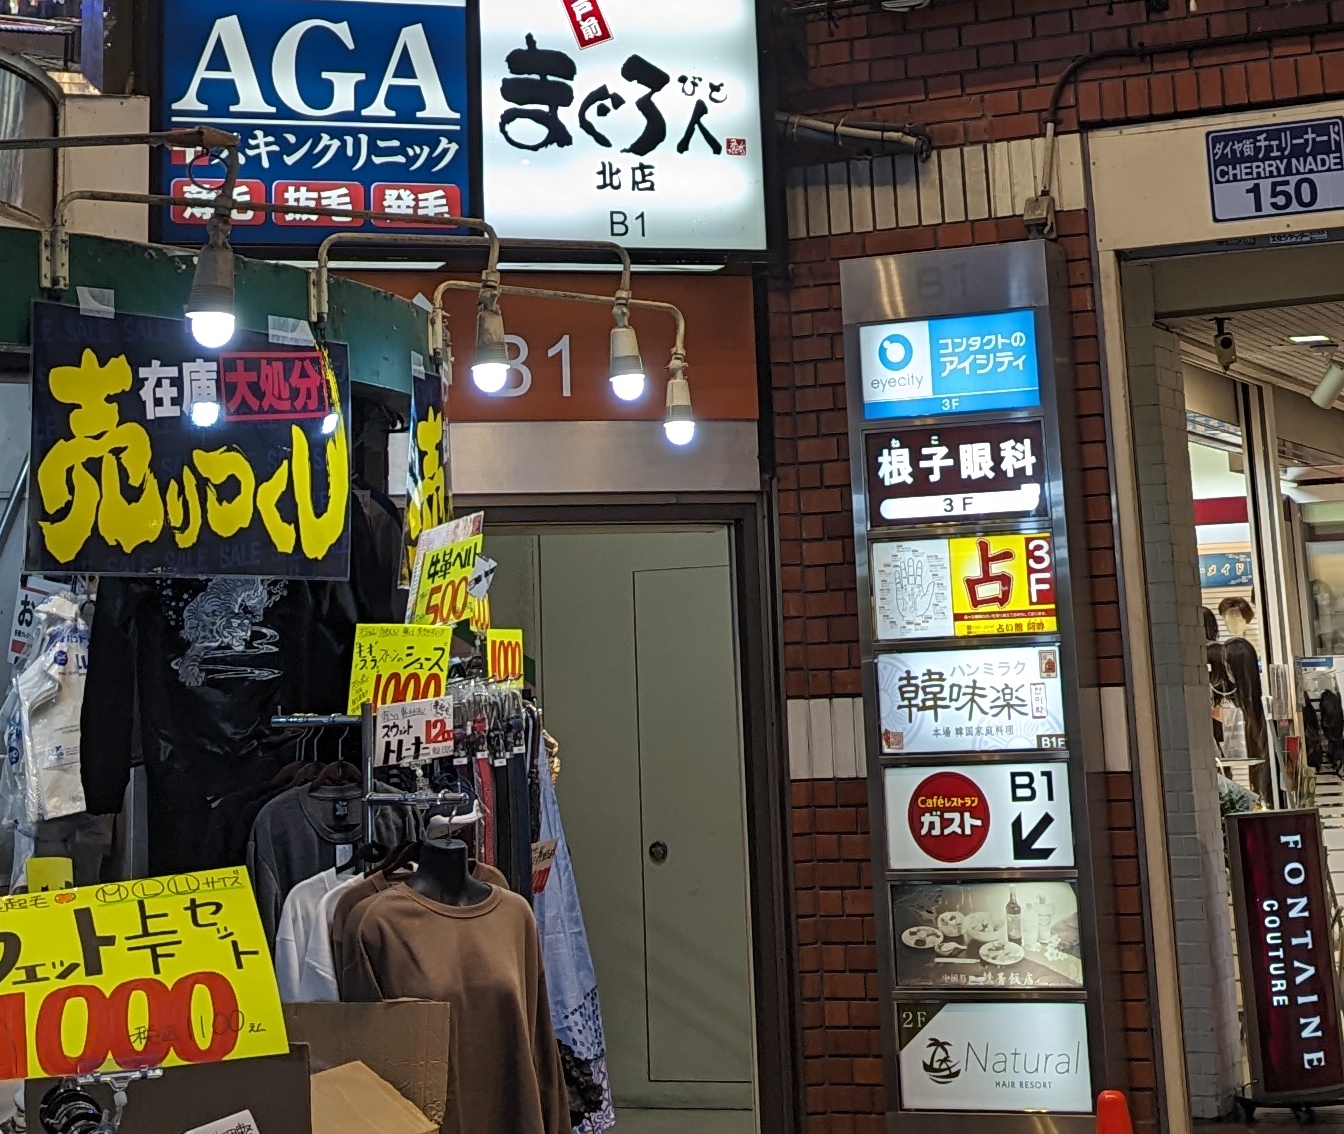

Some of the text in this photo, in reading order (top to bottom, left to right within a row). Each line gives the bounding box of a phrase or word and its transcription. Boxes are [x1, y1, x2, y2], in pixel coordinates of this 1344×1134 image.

[171, 14, 461, 119] AGA
[499, 32, 723, 156] まぐろ人
[596, 161, 656, 192] 北店
[1216, 153, 1342, 182] CHERRY NADE
[1245, 177, 1318, 213] 150
[609, 210, 648, 239] B1
[938, 331, 1026, 354] コンタクトの
[939, 352, 1027, 378] アイシティ
[139, 358, 323, 420] 在庫 大処分
[870, 373, 924, 392] eyecity
[941, 398, 960, 411] 3F
[38, 342, 349, 564] 売りつくし
[877, 438, 1037, 486] 根子眼科
[964, 538, 1016, 610] 占
[1028, 539, 1052, 603] 3F
[424, 575, 470, 626] 500
[491, 639, 522, 681] 1000
[950, 661, 1026, 677] ハンミラク
[372, 671, 442, 714] 1000
[897, 669, 1029, 724] 韓味楽
[381, 719, 414, 739] スウェット
[955, 725, 1014, 737] 韓国家庭料理
[382, 736, 431, 765] トレーナー
[1010, 770, 1054, 802] B1
[920, 811, 982, 836] ガスト
[1263, 899, 1289, 1007] COUTURE
[1280, 833, 1327, 1070] FONTAINE
[902, 1011, 926, 1028] 2F
[965, 1041, 1080, 1075] Natural
[995, 1081, 1052, 1089] HAIR RESORT
